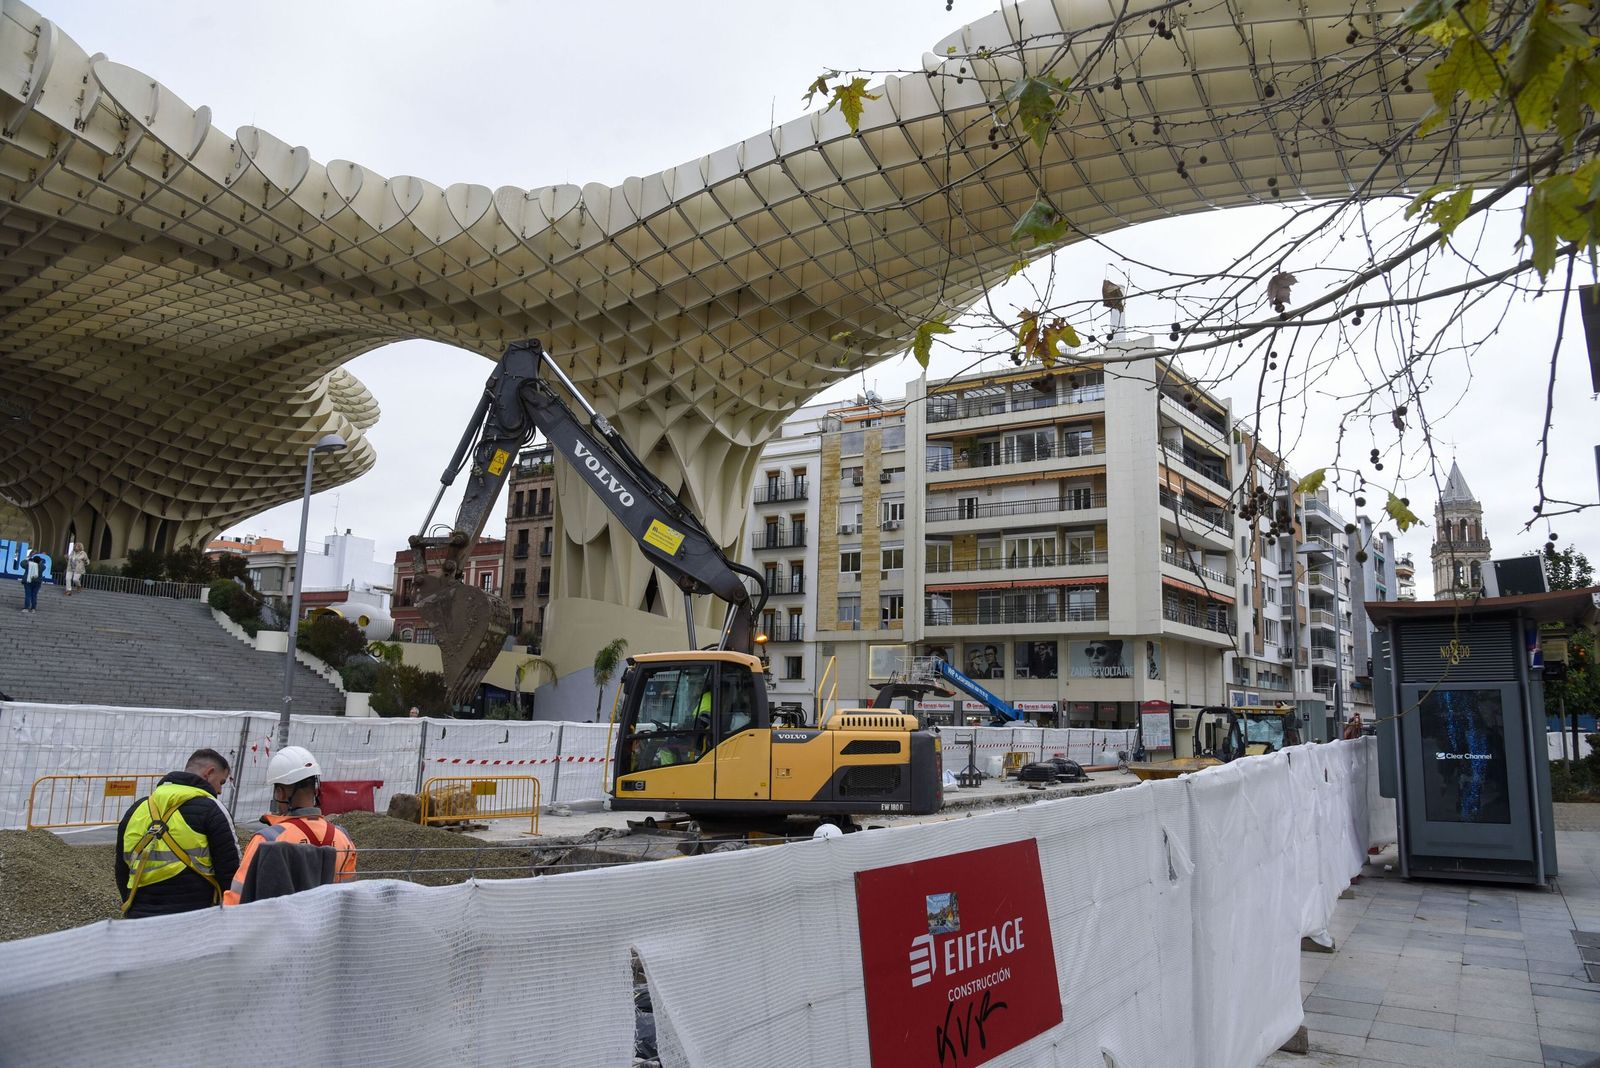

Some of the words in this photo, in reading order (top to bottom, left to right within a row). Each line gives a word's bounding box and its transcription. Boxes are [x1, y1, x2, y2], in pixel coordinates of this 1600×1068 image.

[574, 439, 635, 507] VOLVO
[944, 917, 1025, 976] EIFFAGE
[948, 967, 1011, 1002] CONSTRUCCIÓN
